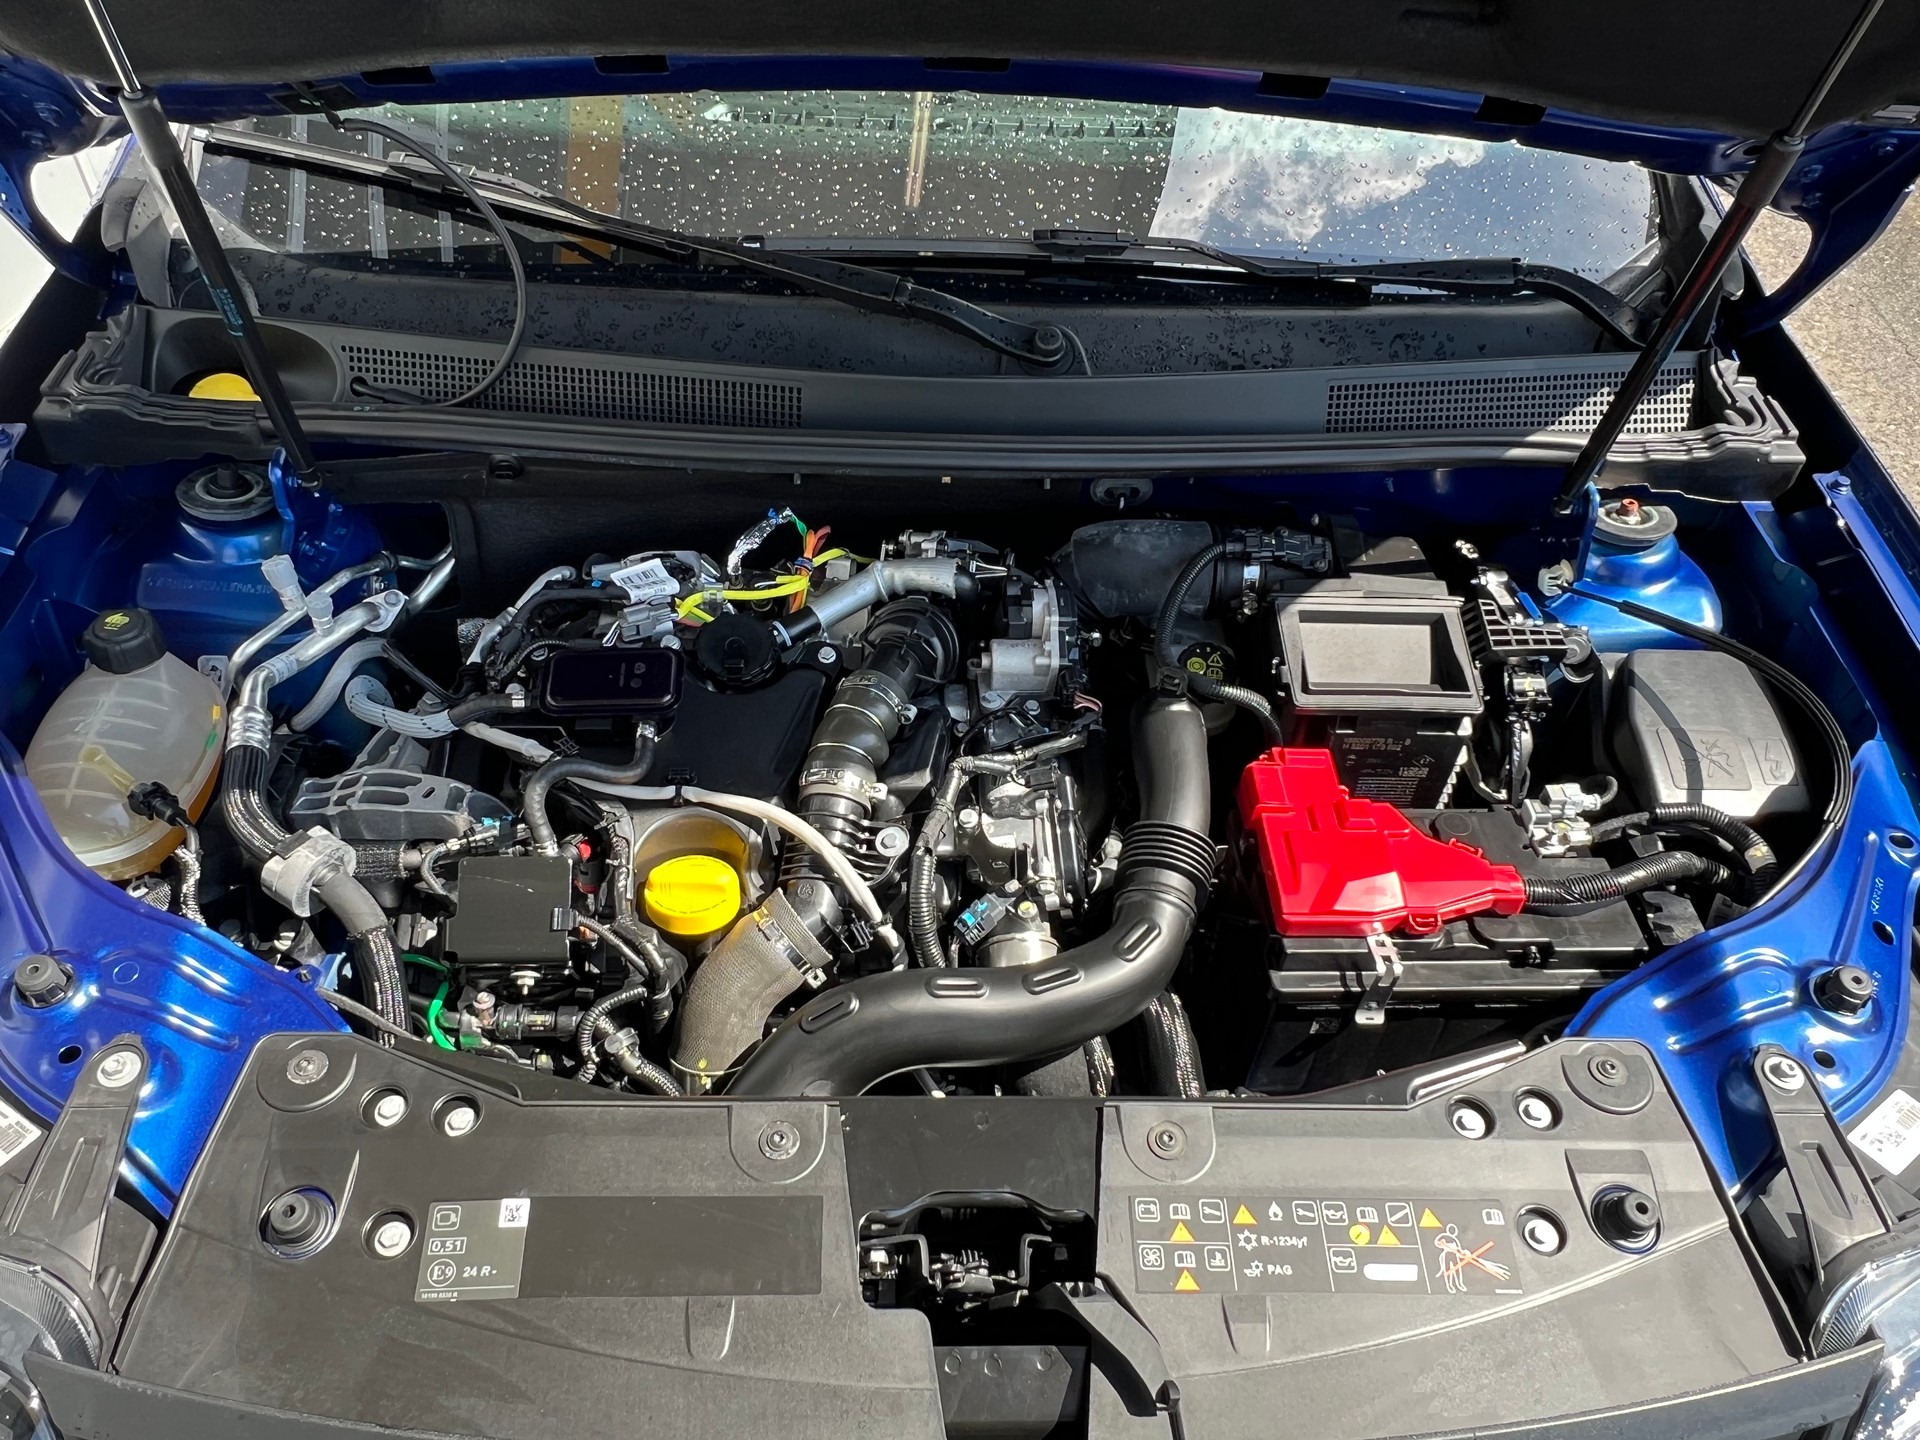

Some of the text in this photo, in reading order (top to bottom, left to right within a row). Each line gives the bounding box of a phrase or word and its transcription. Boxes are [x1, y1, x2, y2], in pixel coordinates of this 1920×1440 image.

[431, 1240, 462, 1253] 0,51
[431, 1265, 454, 1281] E9
[462, 1266, 478, 1278] 24
[1267, 1264, 1293, 1276] PAG
